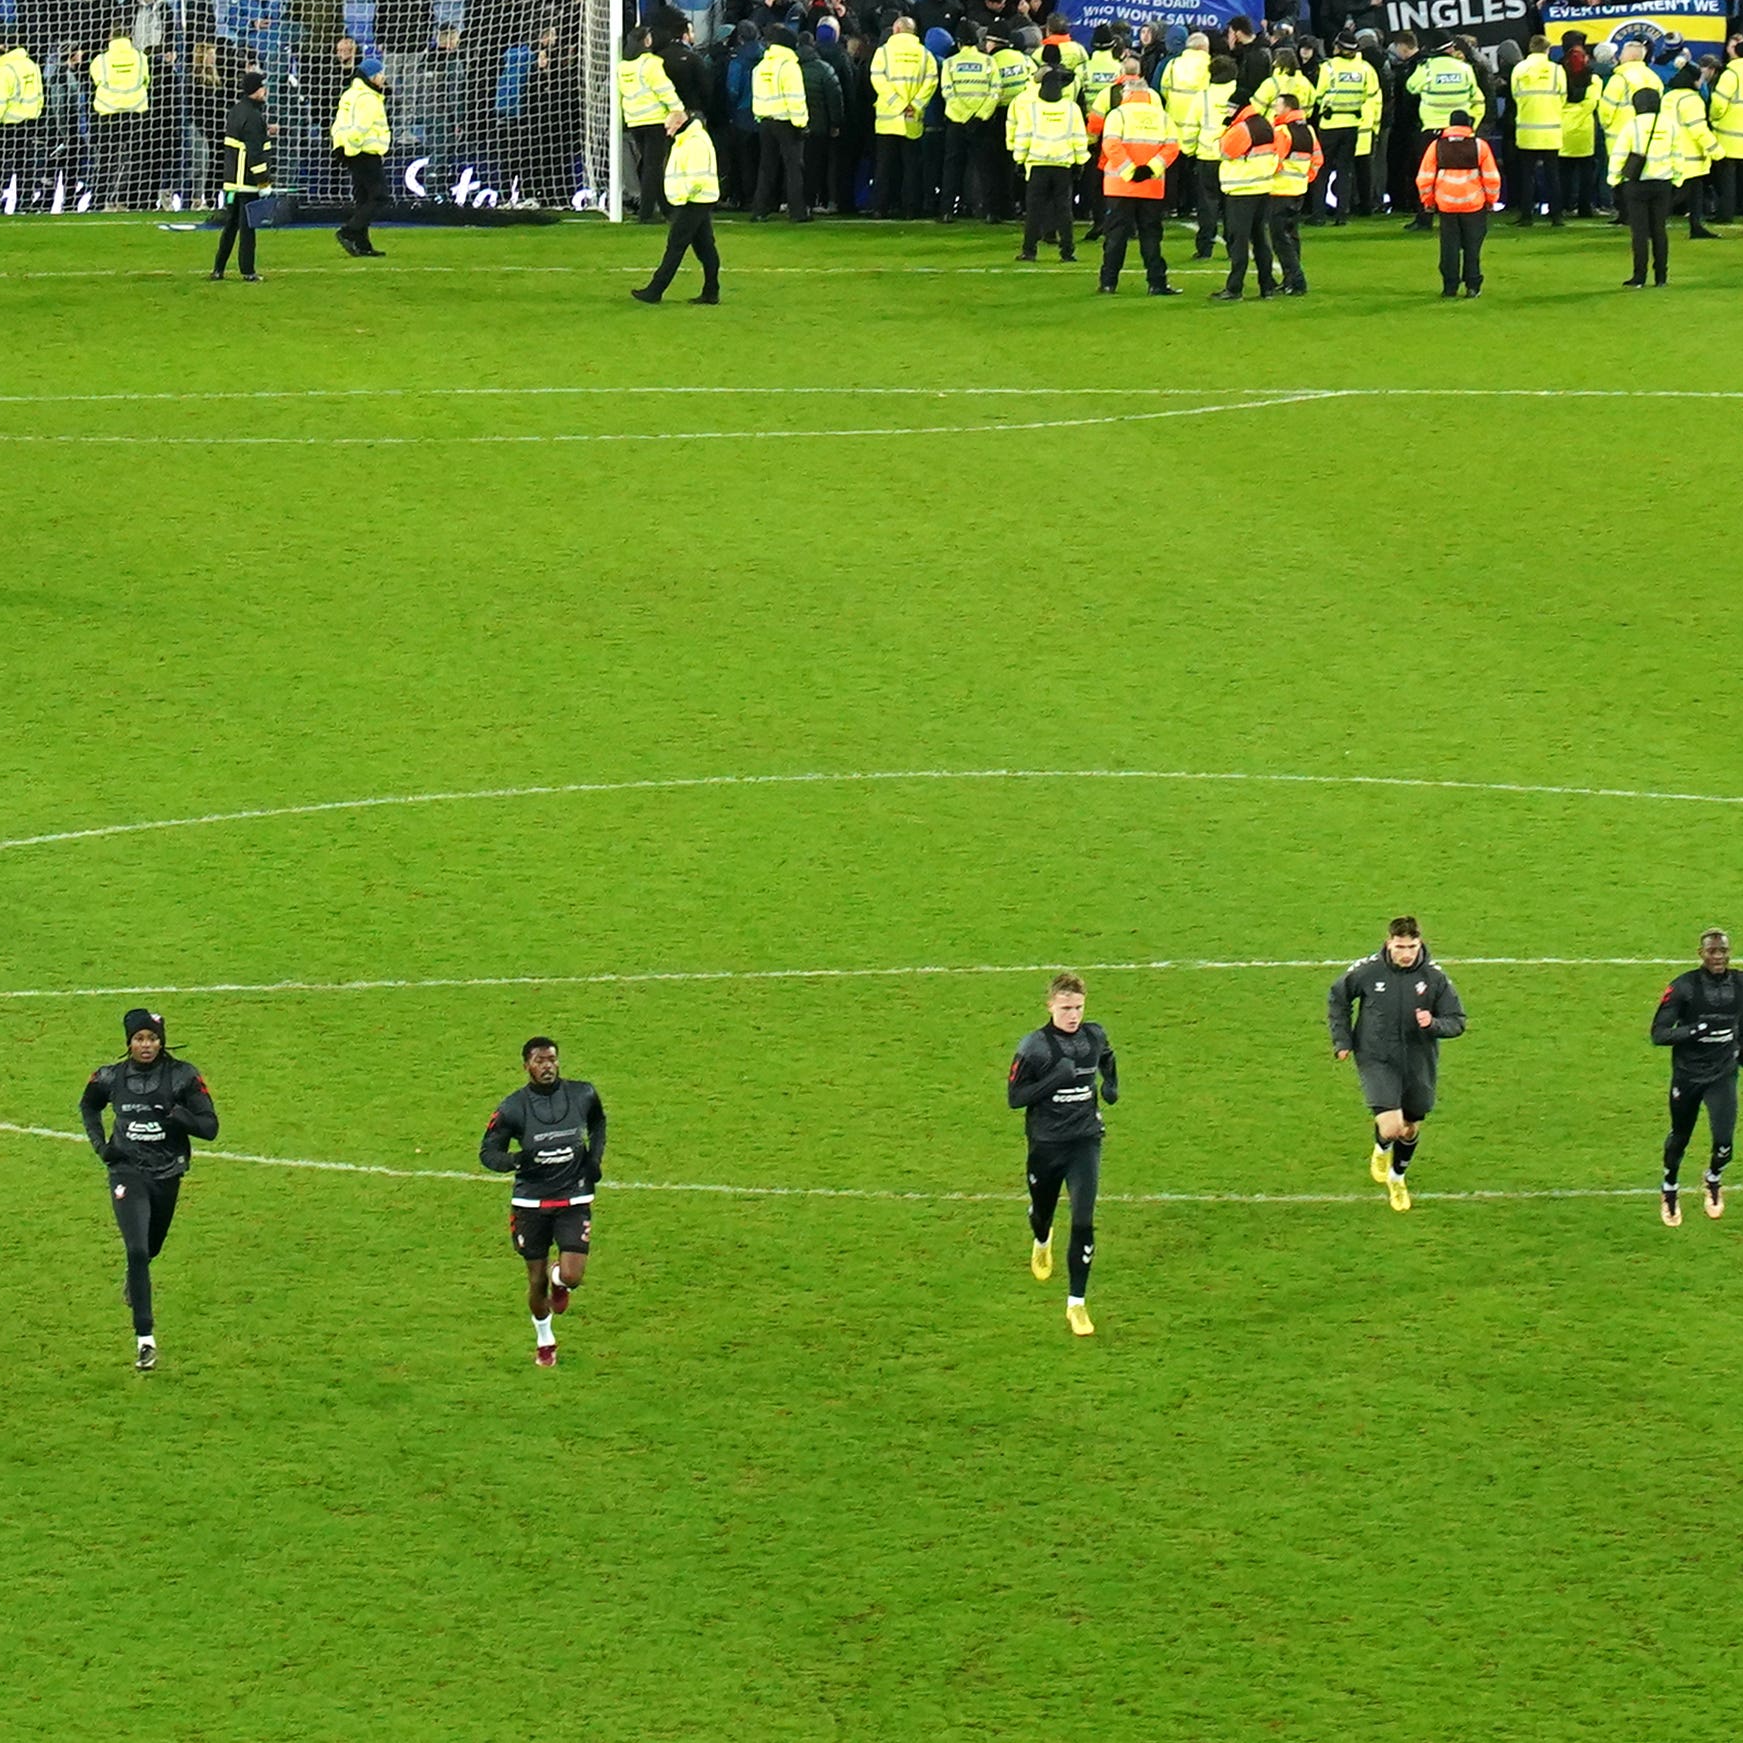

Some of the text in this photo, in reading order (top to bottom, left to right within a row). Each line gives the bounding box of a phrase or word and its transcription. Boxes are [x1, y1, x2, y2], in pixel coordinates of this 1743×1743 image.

[1083, 5, 1113, 18] WHO
[1116, 7, 1164, 23] WON'T
[1165, 13, 1194, 26] SAY
[1548, 2, 1627, 19] EVERTON
[1613, 23, 1663, 43] EVERTON
[957, 63, 982, 72] POLICE
[1436, 74, 1463, 84] POLICE
